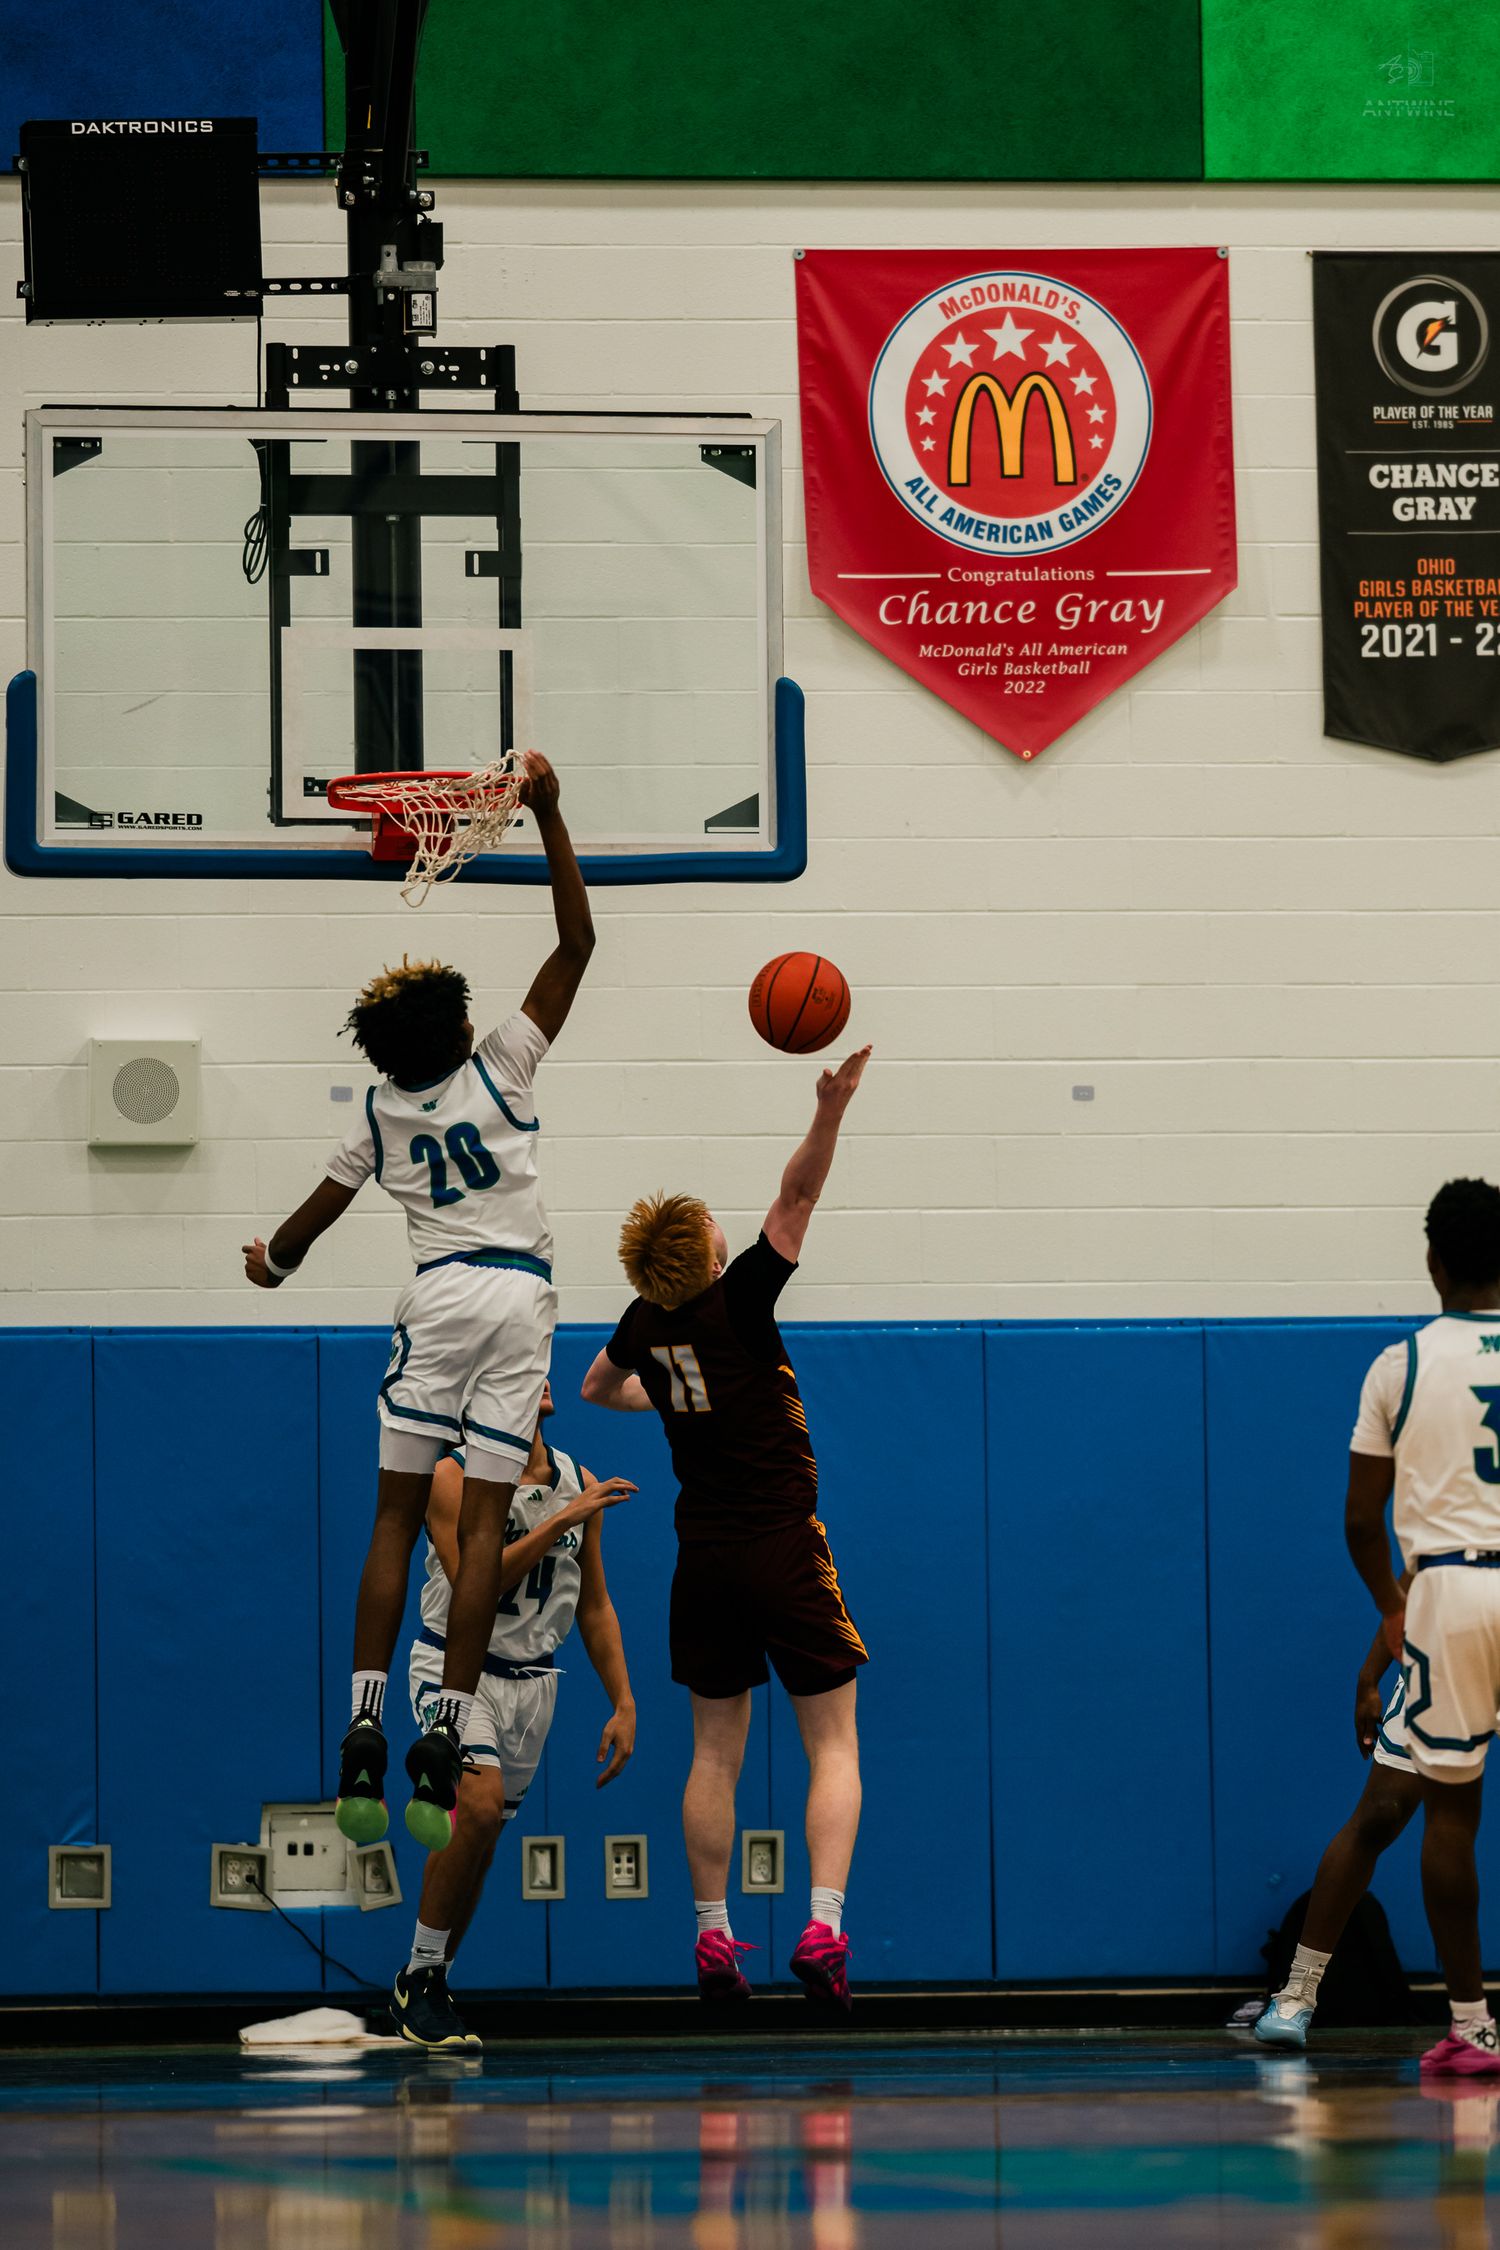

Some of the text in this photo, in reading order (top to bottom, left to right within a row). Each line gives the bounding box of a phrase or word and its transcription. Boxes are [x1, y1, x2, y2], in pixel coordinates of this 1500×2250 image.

[71, 120, 214, 135] DAKTRONICS
[1372, 405, 1493, 419] PLAYER OF THE YEAR
[1412, 420, 1430, 429] EST.
[1369, 463, 1500, 489] CHANCE
[904, 473, 1123, 544] ALL AMERICAN GAMES
[1392, 496, 1476, 521] GRAY
[1417, 558, 1456, 576] OHIO
[947, 567, 1095, 586] Congratulations
[1359, 579, 1500, 597] GIRLS BASKETBA
[878, 590, 1165, 634] Chance Gray
[1354, 600, 1500, 618] PLAYER OF THE YE
[1361, 623, 1437, 658] 2021
[1475, 622, 1500, 656] 2
[918, 643, 1128, 658] McDonald's All American
[958, 661, 1091, 677] Girls Basketball
[1003, 680, 1046, 694] 2022
[118, 812, 202, 826] GARED
[409, 1121, 501, 1209] 20
[650, 1344, 712, 1413] 11
